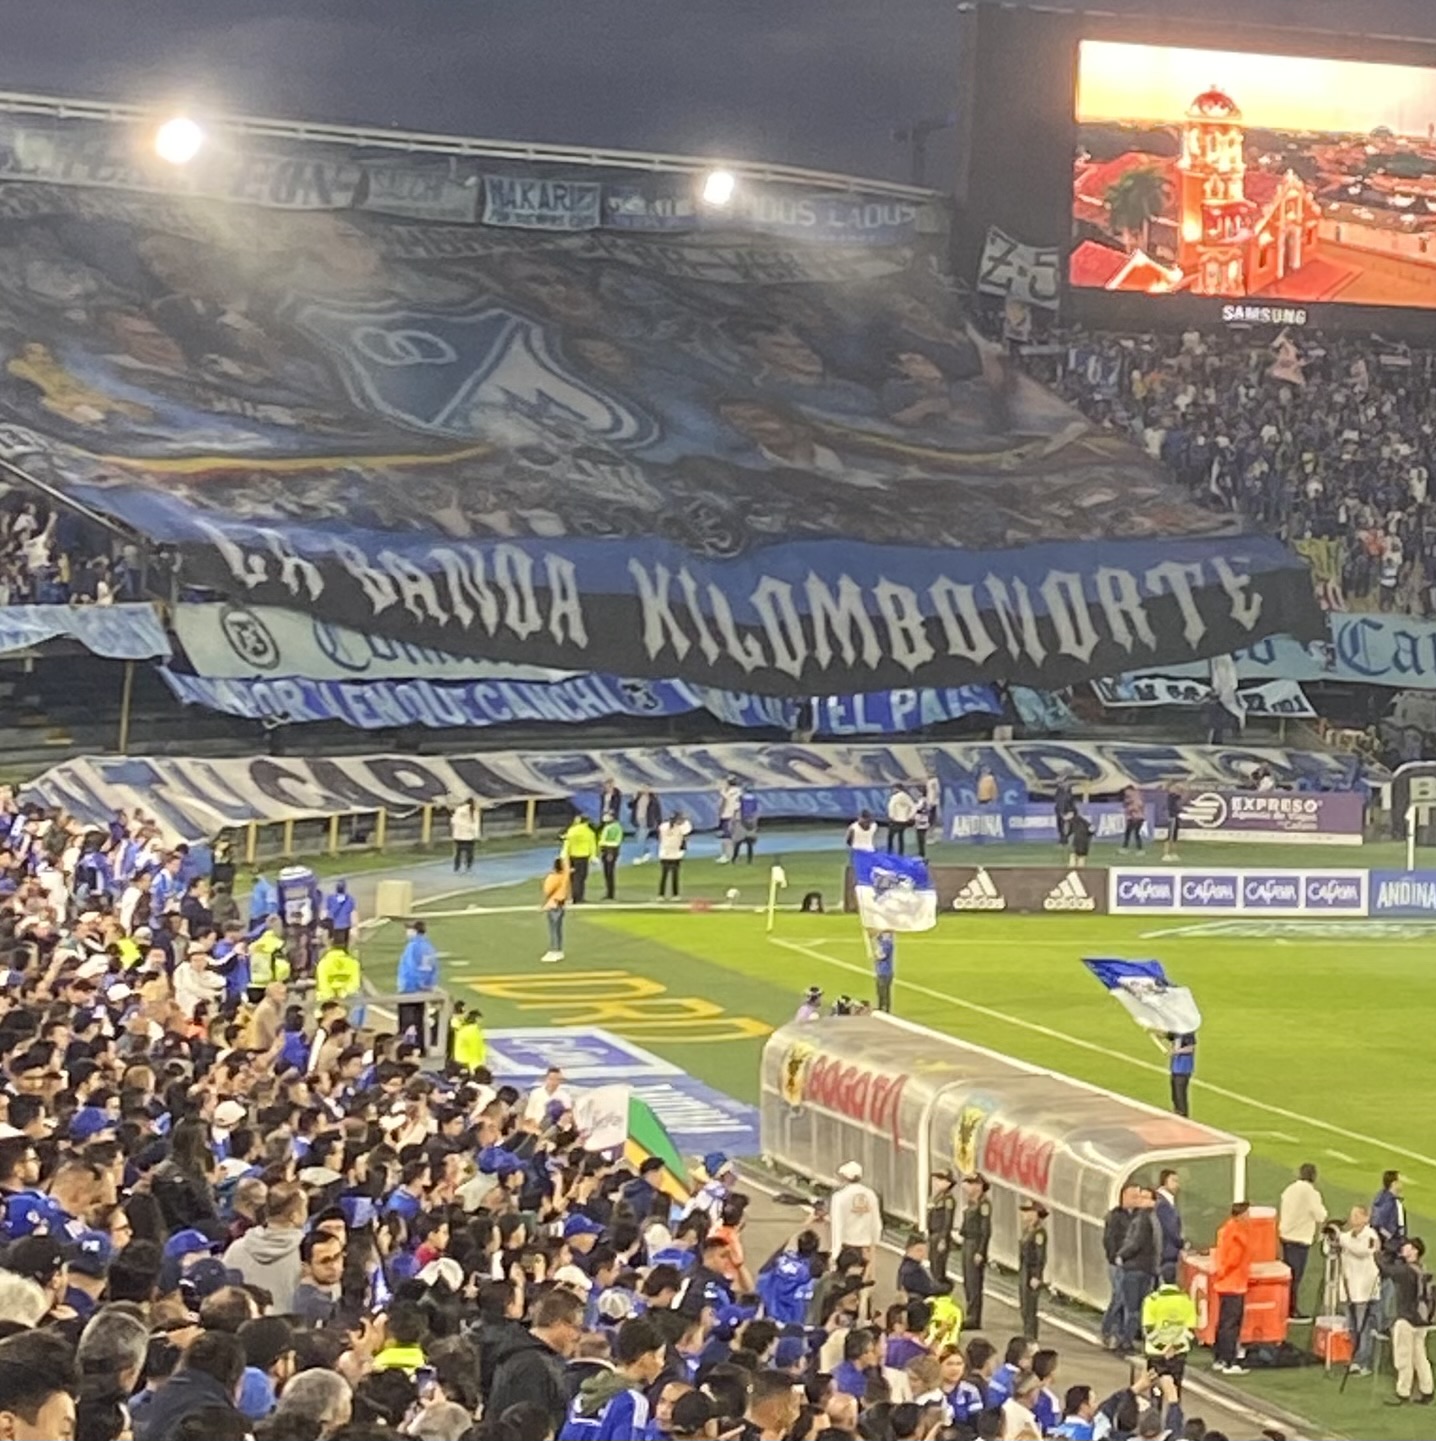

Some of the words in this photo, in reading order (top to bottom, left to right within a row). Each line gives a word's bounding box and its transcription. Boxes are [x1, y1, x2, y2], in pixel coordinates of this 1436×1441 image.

[1222, 305, 1307, 325] SAMSUNG
[331, 537, 588, 648] BANDA
[628, 555, 1262, 681] KILOMBONORTE
[1232, 796, 1317, 812] EXPRESO
